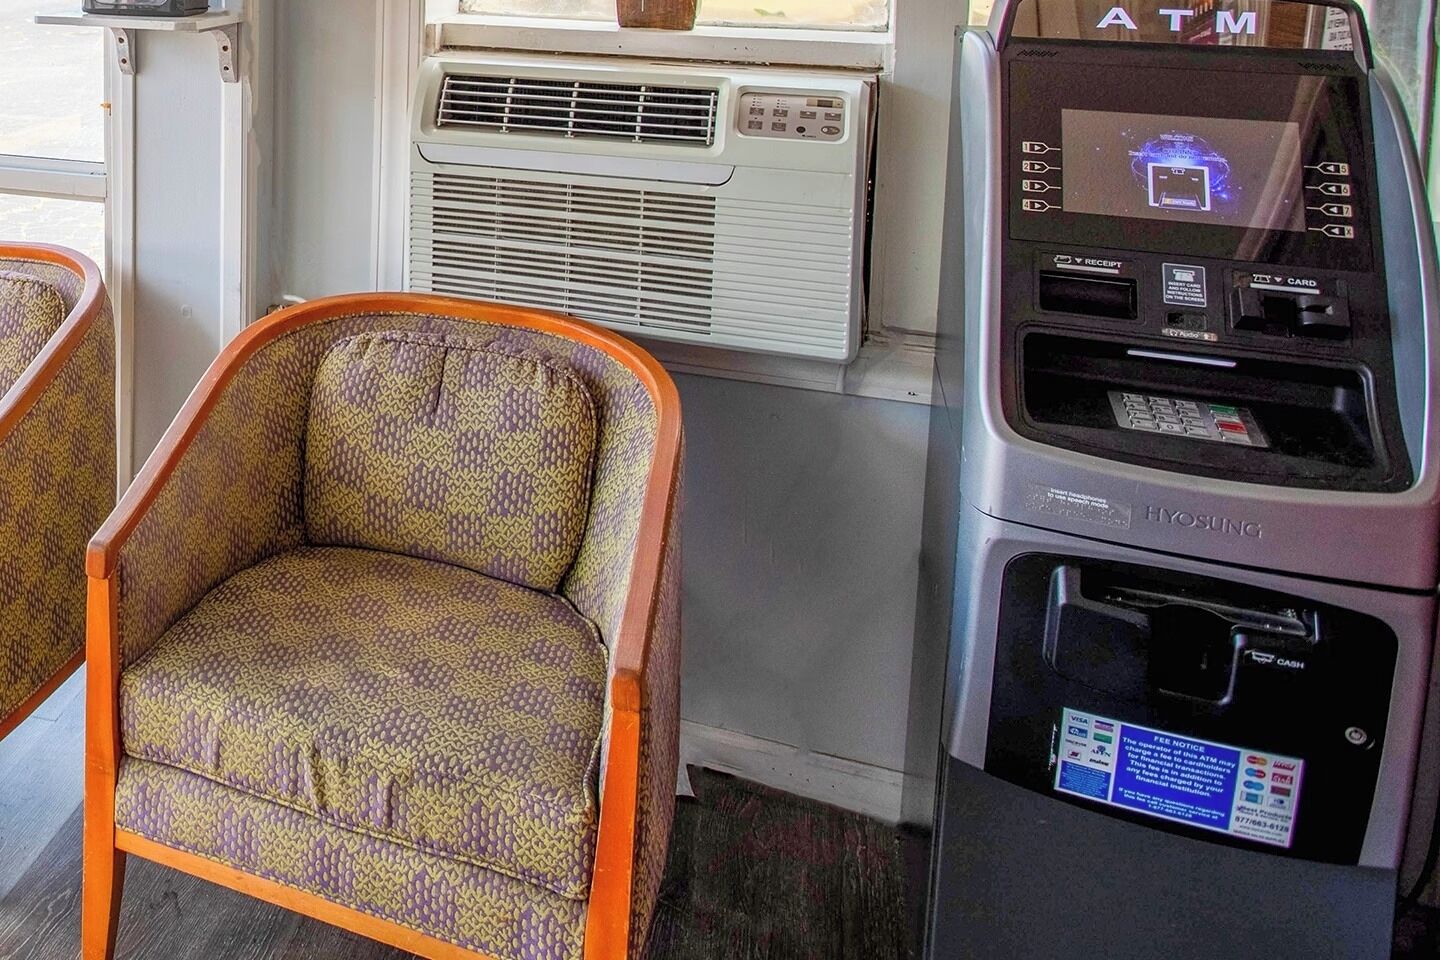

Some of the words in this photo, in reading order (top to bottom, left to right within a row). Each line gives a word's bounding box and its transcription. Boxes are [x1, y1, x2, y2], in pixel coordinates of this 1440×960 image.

[1096, 7, 1257, 34] ATM
[1085, 259, 1122, 268] RECEIPT
[1287, 278, 1317, 287] CARD
[1051, 488, 1068, 496] Insert
[1069, 491, 1106, 503] headphones
[1068, 496, 1090, 505] speech
[1091, 501, 1109, 509] mode
[1146, 506, 1262, 539] HYOSUNG
[1277, 659, 1304, 669] CASH
[1071, 715, 1088, 724] VISA
[1153, 735, 1170, 744] FEE
[1172, 740, 1205, 752] NOTICE
[1124, 744, 1151, 756] charge
[1160, 752, 1171, 760] fee
[1183, 758, 1231, 773] cardholders
[1138, 741, 1170, 753] operator
[1183, 750, 1198, 758] this
[1199, 754, 1217, 763] ATM
[1218, 759, 1235, 768] may
[1130, 759, 1146, 768] This
[1148, 763, 1159, 771] fee
[1180, 771, 1211, 783] addition
[1140, 755, 1173, 767] financial
[1175, 763, 1225, 779] transactions.
[1126, 766, 1140, 774] any
[1142, 769, 1158, 777] fees
[1160, 773, 1191, 786] charged
[1193, 781, 1203, 789] by
[1205, 785, 1223, 793] your
[1135, 775, 1168, 787] financial
